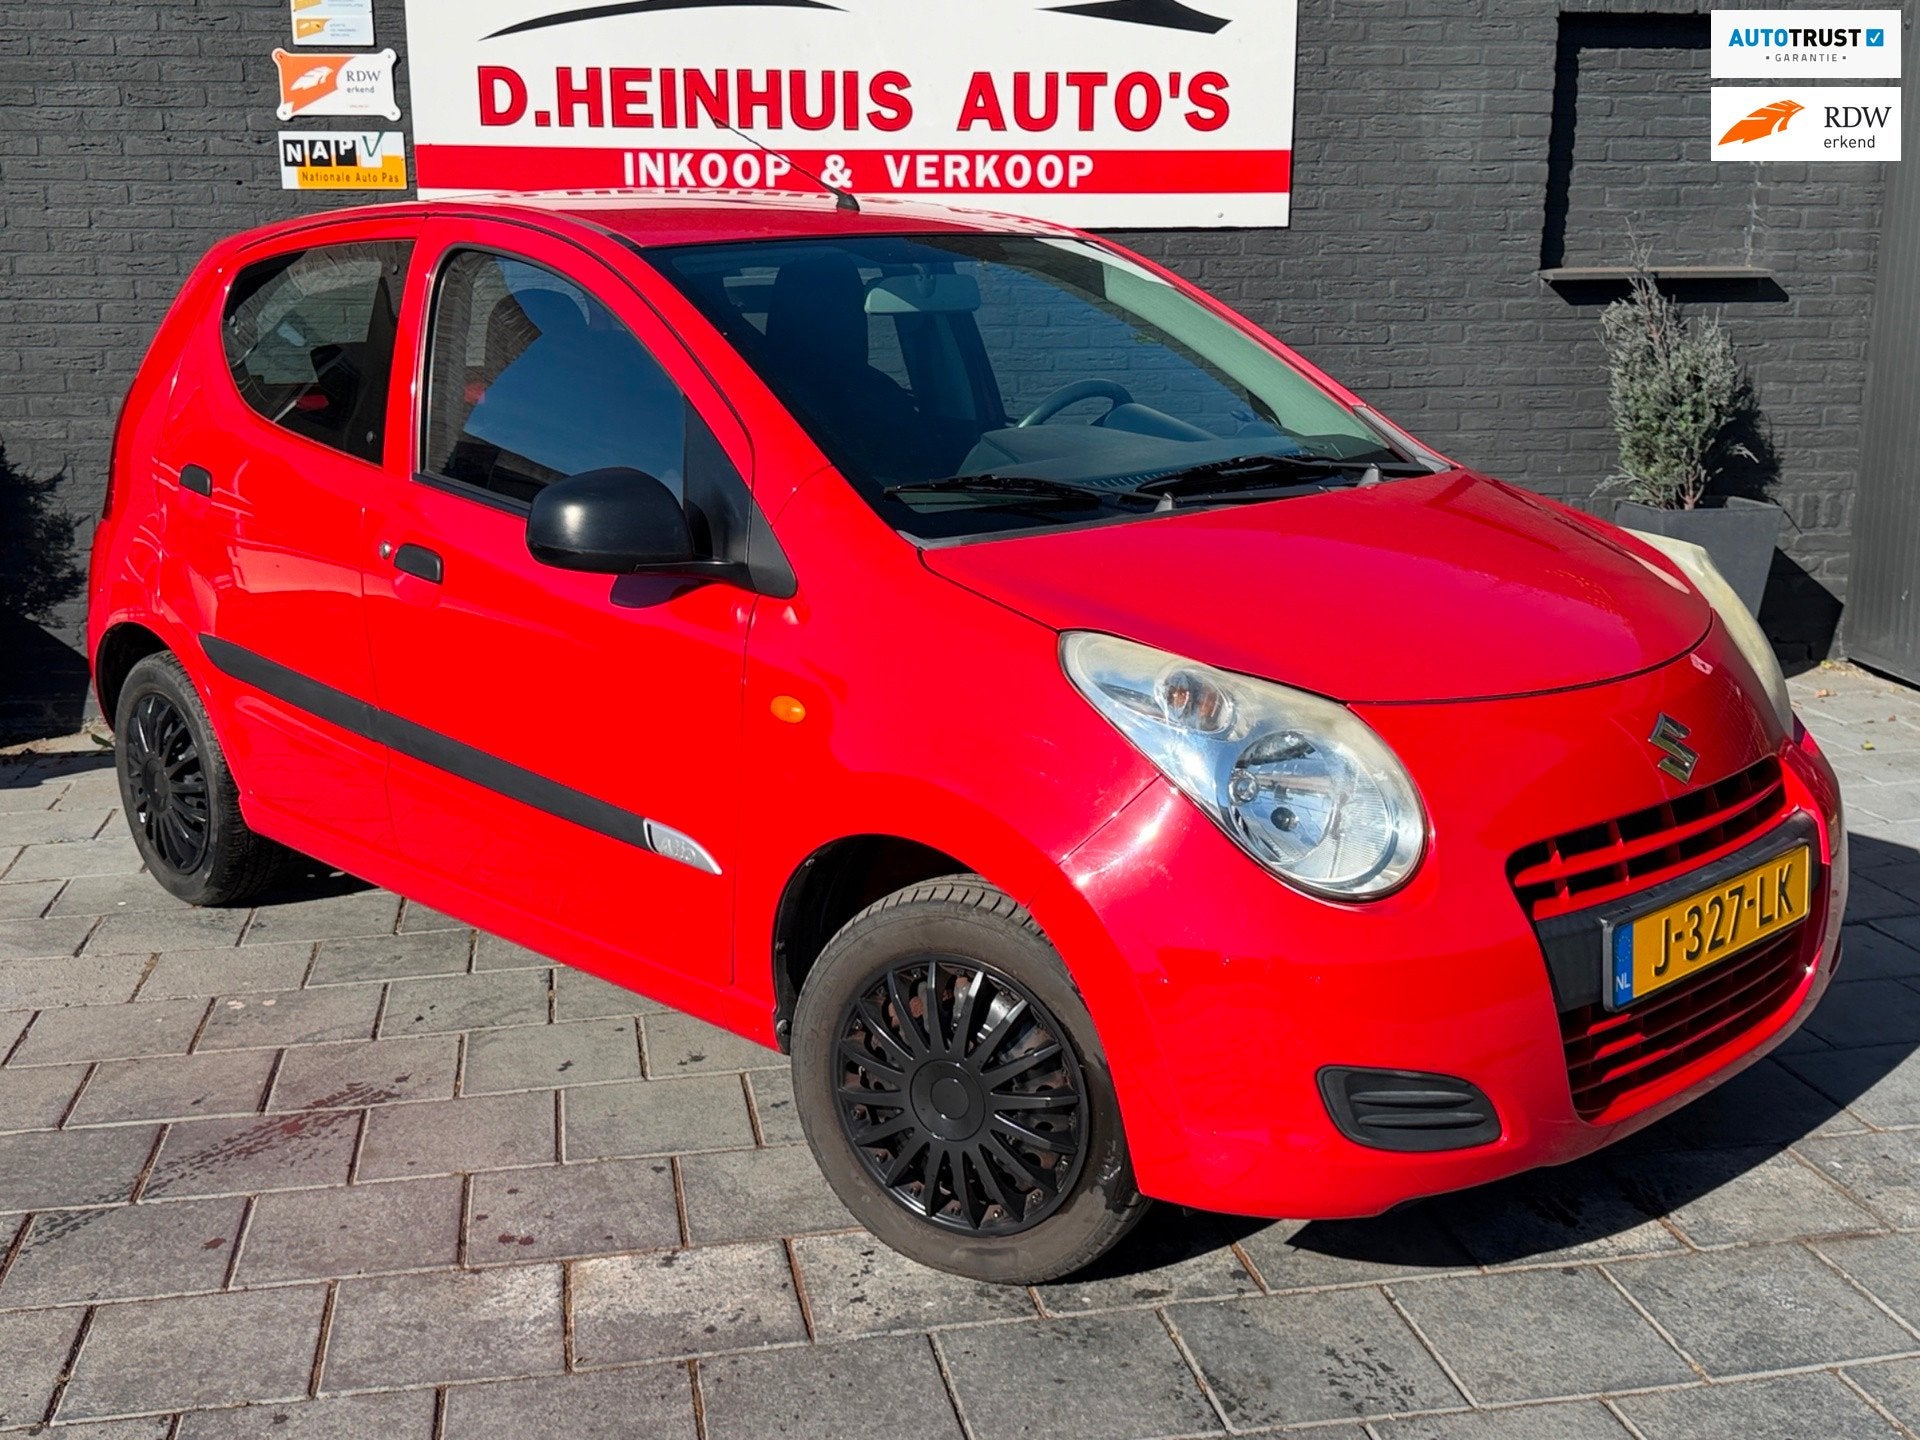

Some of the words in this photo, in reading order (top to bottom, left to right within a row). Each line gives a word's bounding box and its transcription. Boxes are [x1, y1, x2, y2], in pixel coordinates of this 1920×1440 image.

[346, 70, 381, 82] RDW
[346, 85, 375, 94] erkend
[477, 65, 913, 132] D.HEINHUIS
[956, 71, 1230, 132] AUTO'S
[301, 171, 351, 183] Nationale
[355, 172, 378, 183] Auto
[381, 172, 400, 184] Pas
[624, 151, 791, 188] INKOOP
[820, 154, 853, 188] &
[884, 154, 1094, 188] VERKOOP
[1652, 860, 1794, 978] J-327-LK
[1615, 972, 1631, 992] NL
